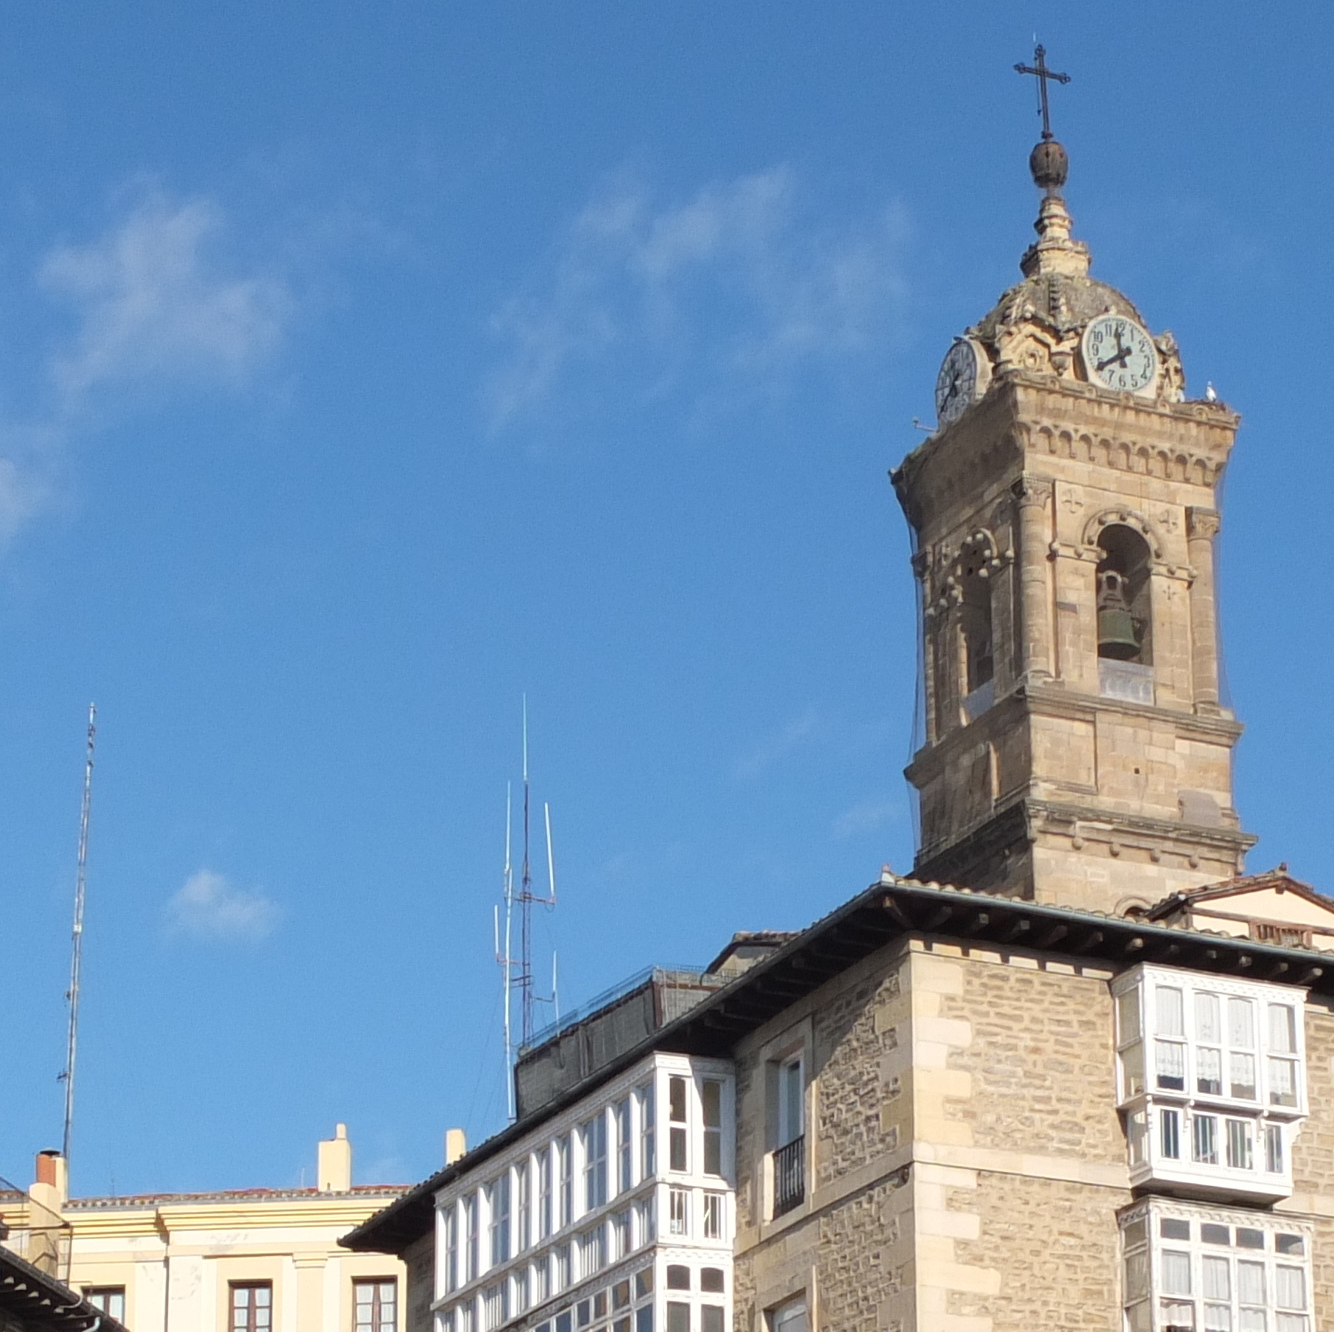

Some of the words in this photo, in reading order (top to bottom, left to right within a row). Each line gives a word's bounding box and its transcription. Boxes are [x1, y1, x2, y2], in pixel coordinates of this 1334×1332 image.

[1105, 323, 1113, 337] 11
[1093, 331, 1103, 344] 10
[1092, 343, 1099, 356] 9
[1138, 340, 1146, 353] 2
[1144, 355, 1151, 368] 3
[1108, 369, 1115, 385] 7
[1140, 364, 1147, 380] 4
[1119, 374, 1126, 388] 6
[1130, 374, 1138, 387] 5
